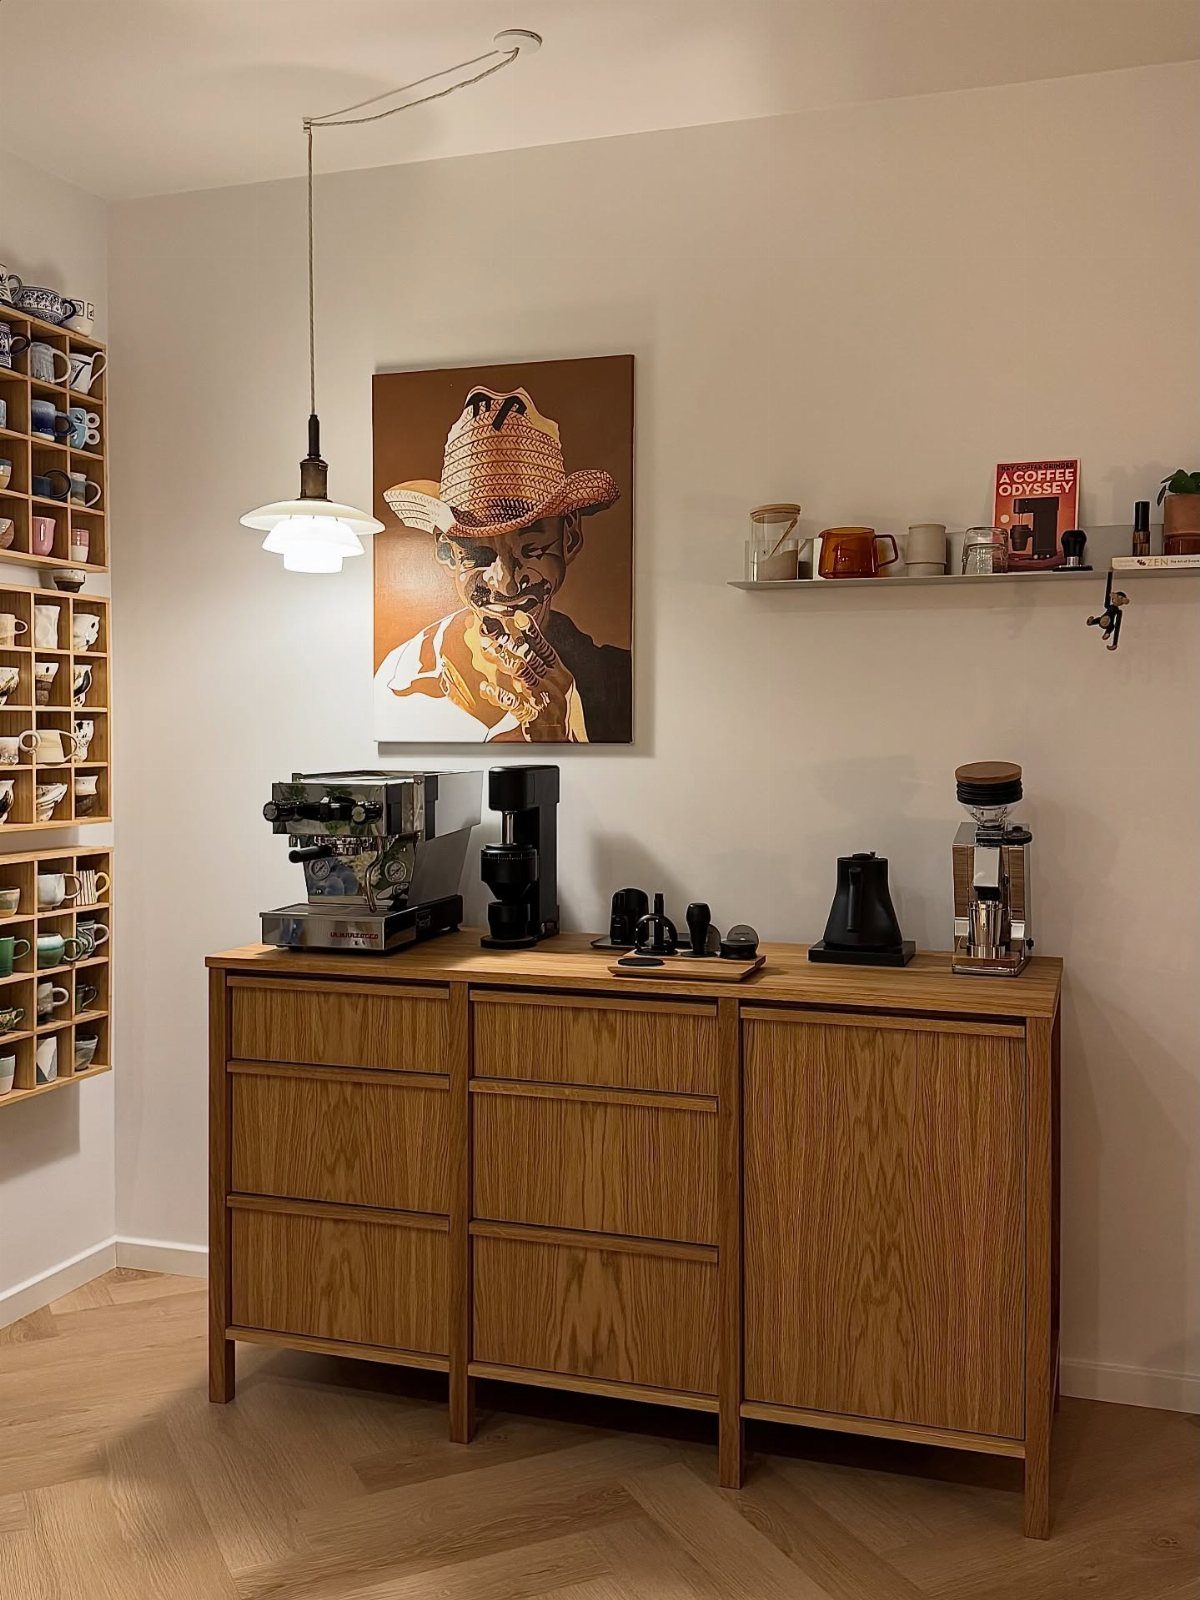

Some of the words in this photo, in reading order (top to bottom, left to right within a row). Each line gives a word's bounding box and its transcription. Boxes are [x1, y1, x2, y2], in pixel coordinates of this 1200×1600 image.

[999, 471, 1011, 484] A
[1013, 469, 1075, 483] COFFEE
[998, 481, 1074, 496] ODYSSEY
[1147, 558, 1169, 567] ZEN
